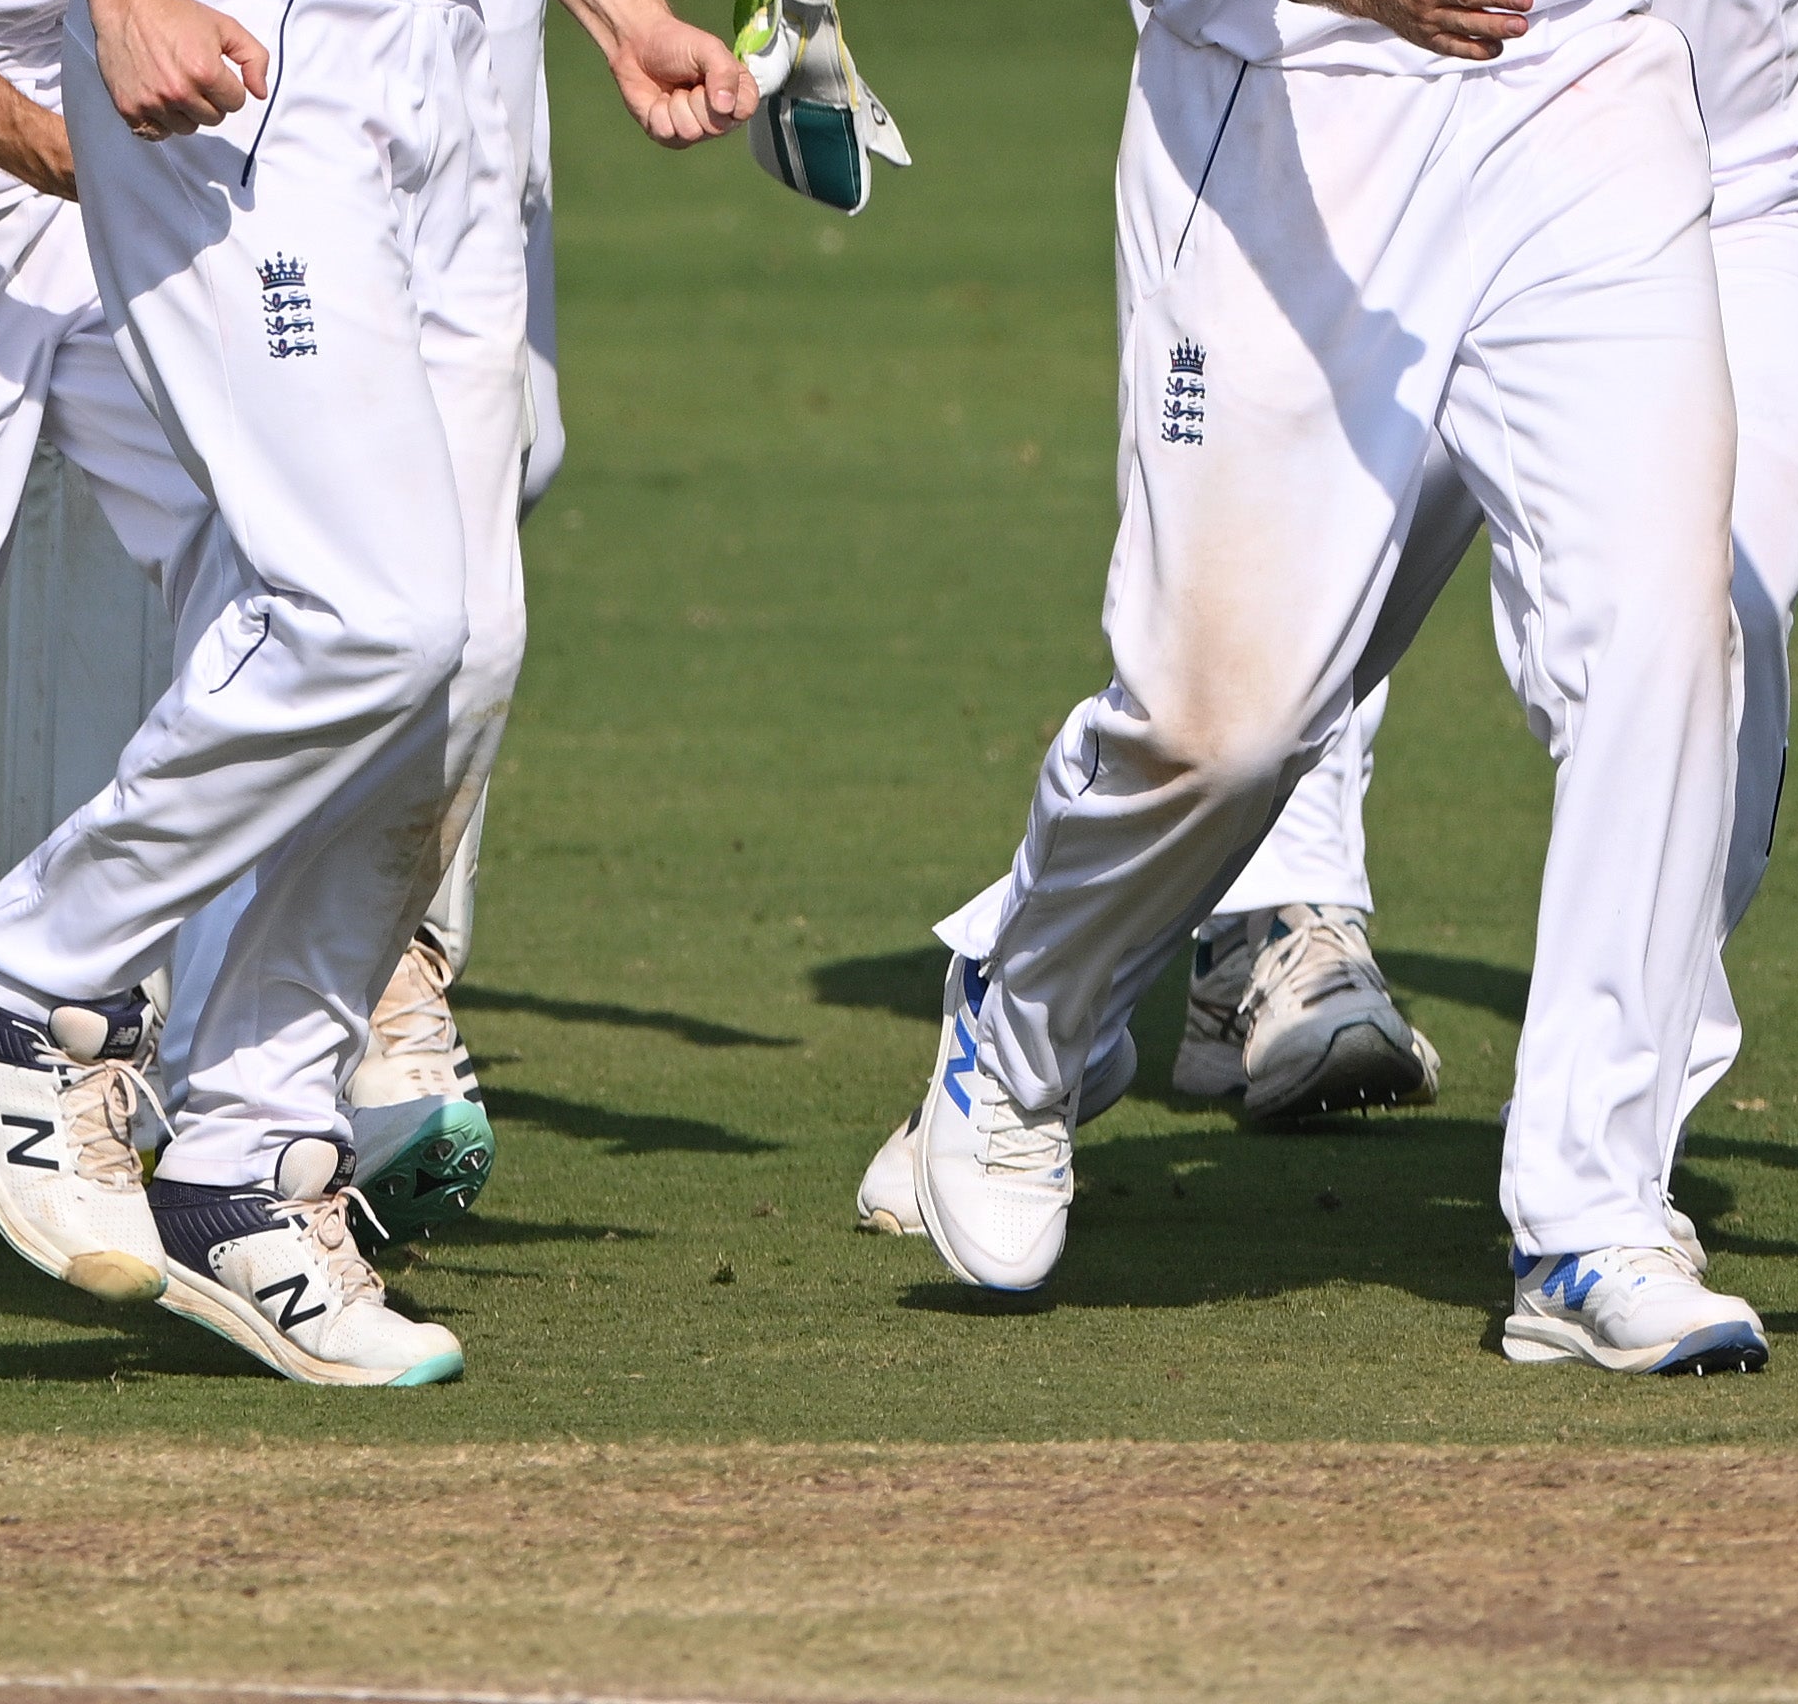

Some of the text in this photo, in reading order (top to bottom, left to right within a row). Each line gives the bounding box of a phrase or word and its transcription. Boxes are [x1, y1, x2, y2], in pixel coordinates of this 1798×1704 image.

[0, 1113, 61, 1171] N
[254, 1271, 327, 1331] N
[1541, 1253, 1602, 1311] N
